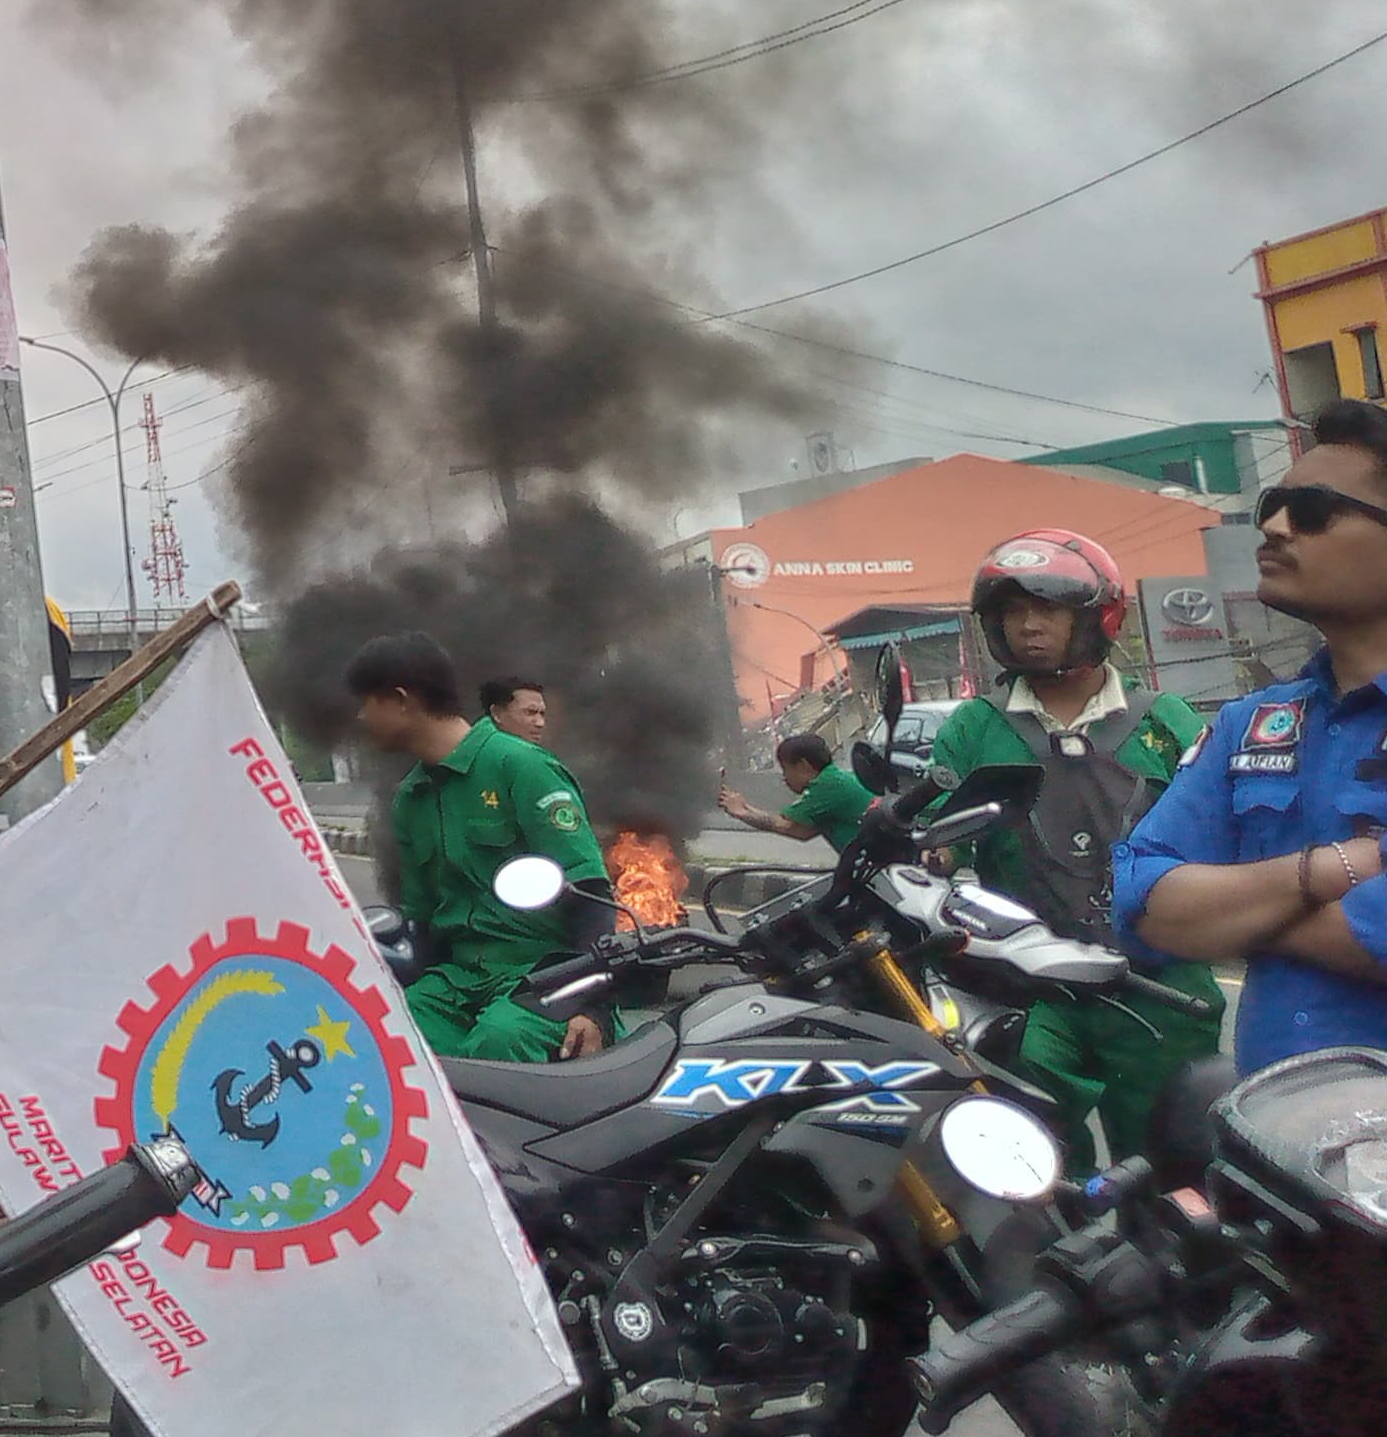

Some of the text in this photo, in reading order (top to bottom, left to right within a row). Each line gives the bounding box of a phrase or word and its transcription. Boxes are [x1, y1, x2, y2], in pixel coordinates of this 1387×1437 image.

[774, 560, 914, 576] ANNA SKIN CLINIC
[650, 1058, 941, 1113] KLX
[18, 1095, 84, 1187] MARIT
[88, 1260, 194, 1379] SELATAN
